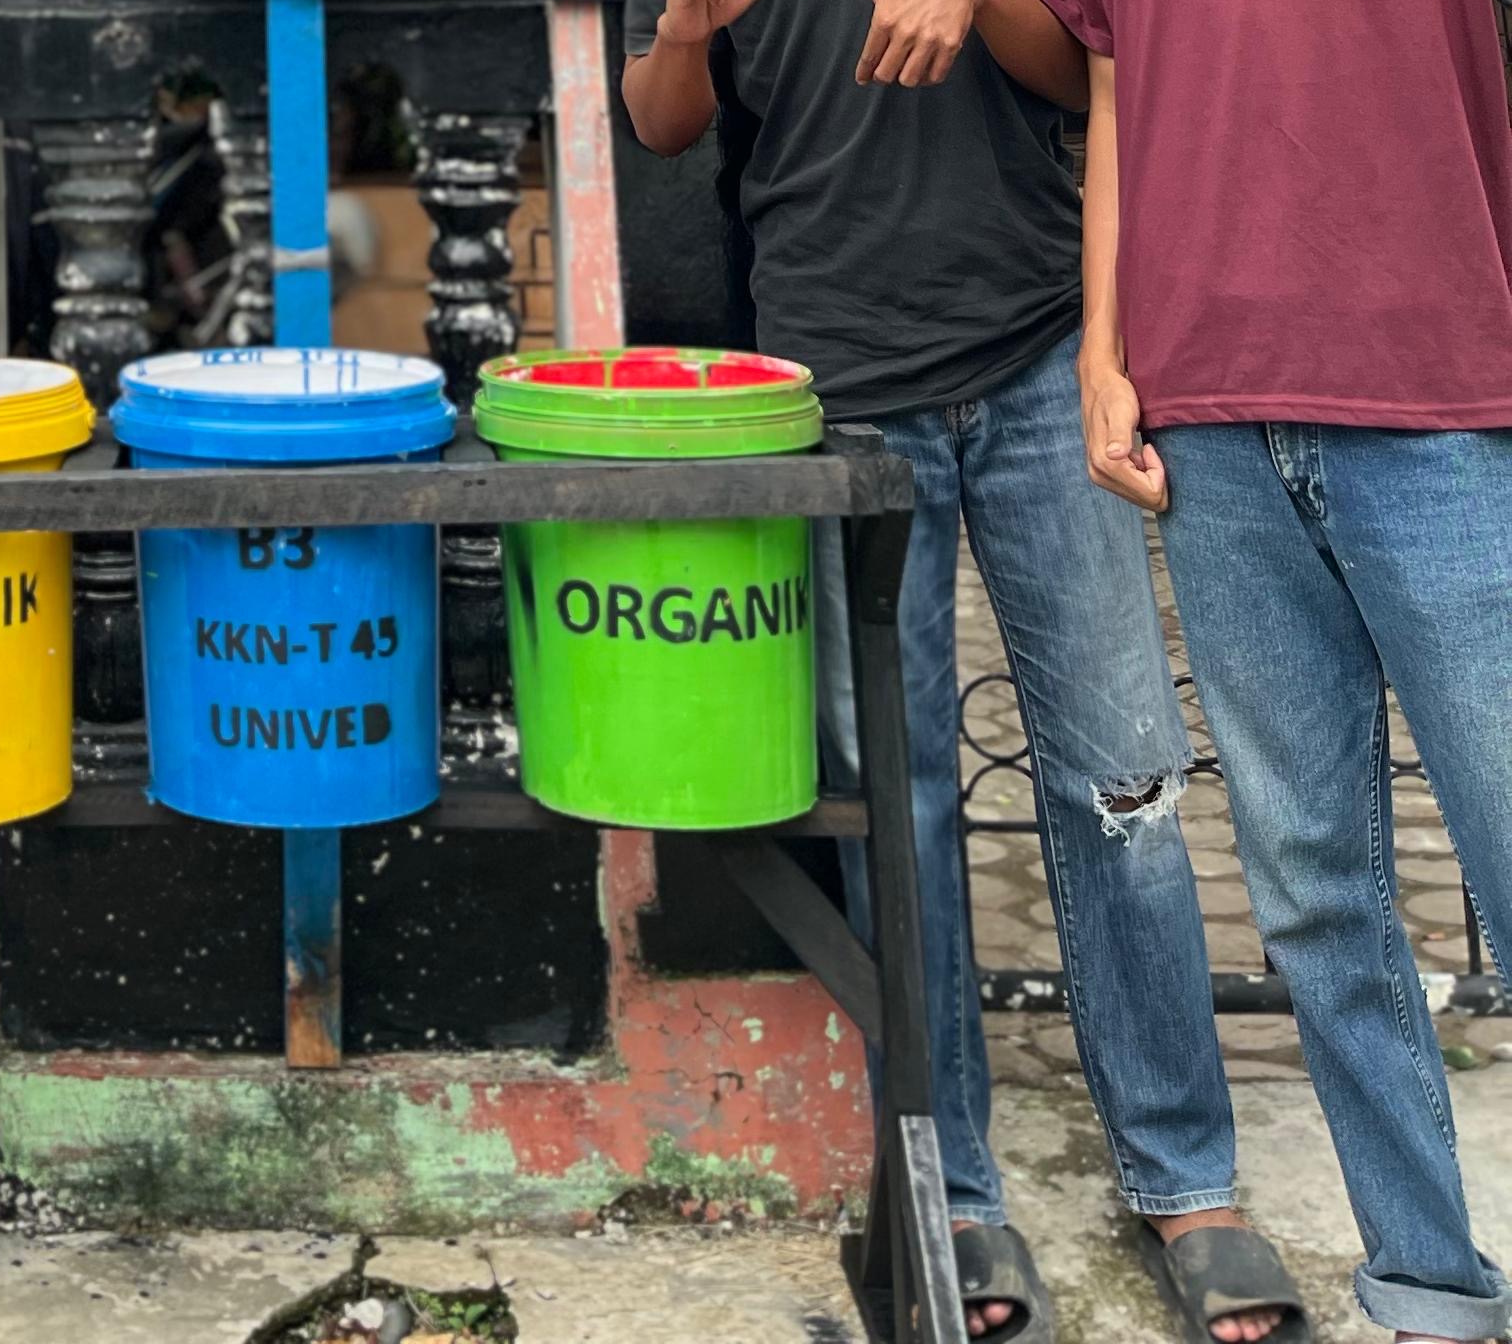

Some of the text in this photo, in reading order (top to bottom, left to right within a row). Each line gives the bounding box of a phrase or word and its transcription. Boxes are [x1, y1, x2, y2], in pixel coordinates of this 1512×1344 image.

[239, 527, 316, 570] B3
[197, 616, 399, 665] KKN-T 45
[211, 703, 392, 750] UNIVED
